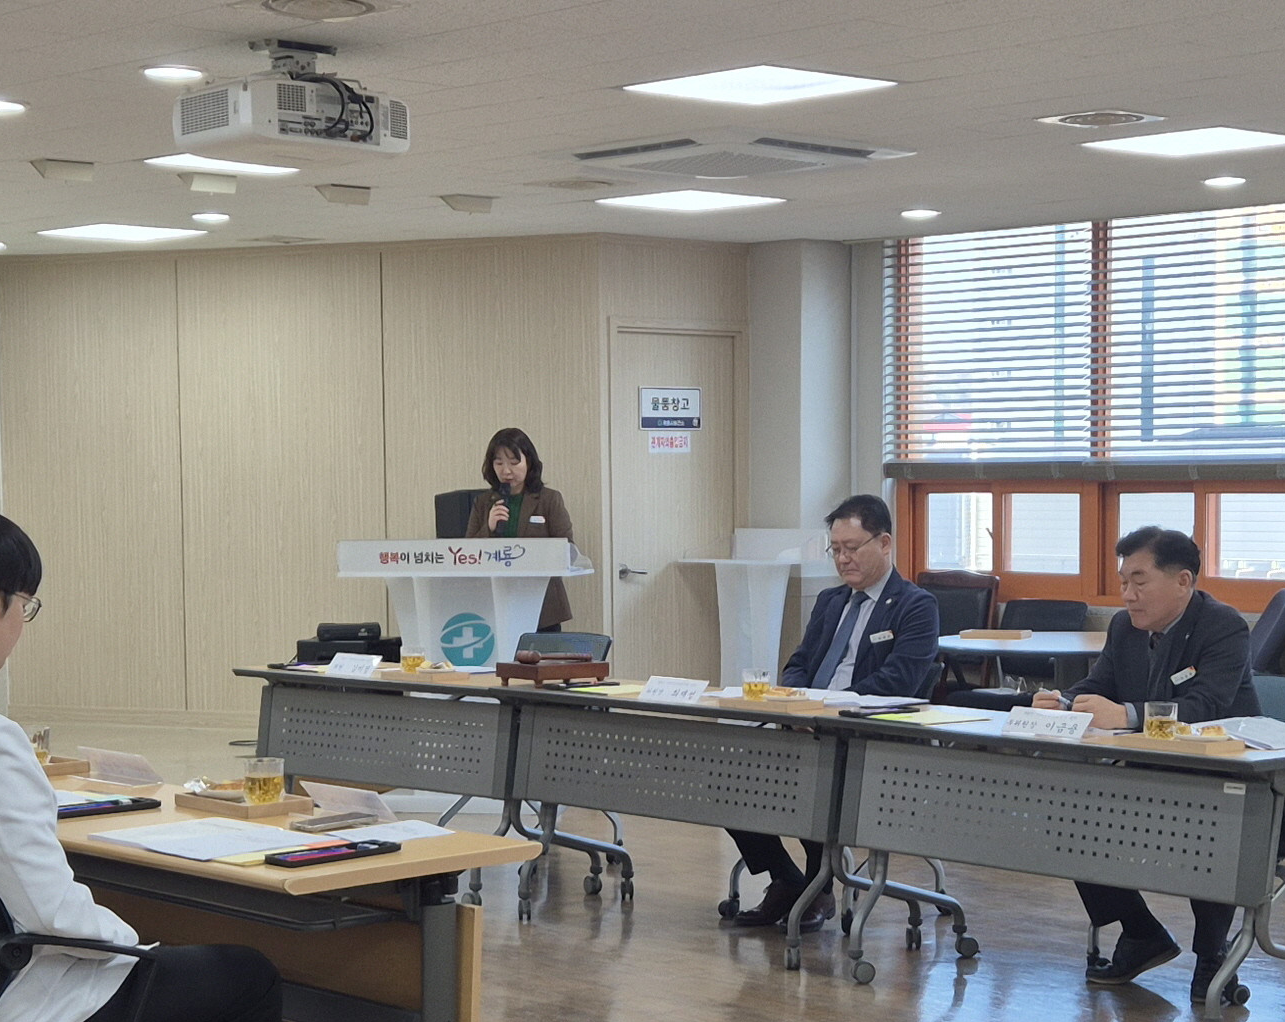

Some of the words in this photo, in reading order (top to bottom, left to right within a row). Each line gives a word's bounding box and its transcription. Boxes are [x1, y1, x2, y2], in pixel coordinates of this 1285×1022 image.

[651, 397, 690, 411] 물품창고
[379, 552, 410, 564] 행복이
[415, 552, 445, 564] 넘치는
[448, 546, 482, 566] Yes!
[485, 546, 520, 567] 계룡
